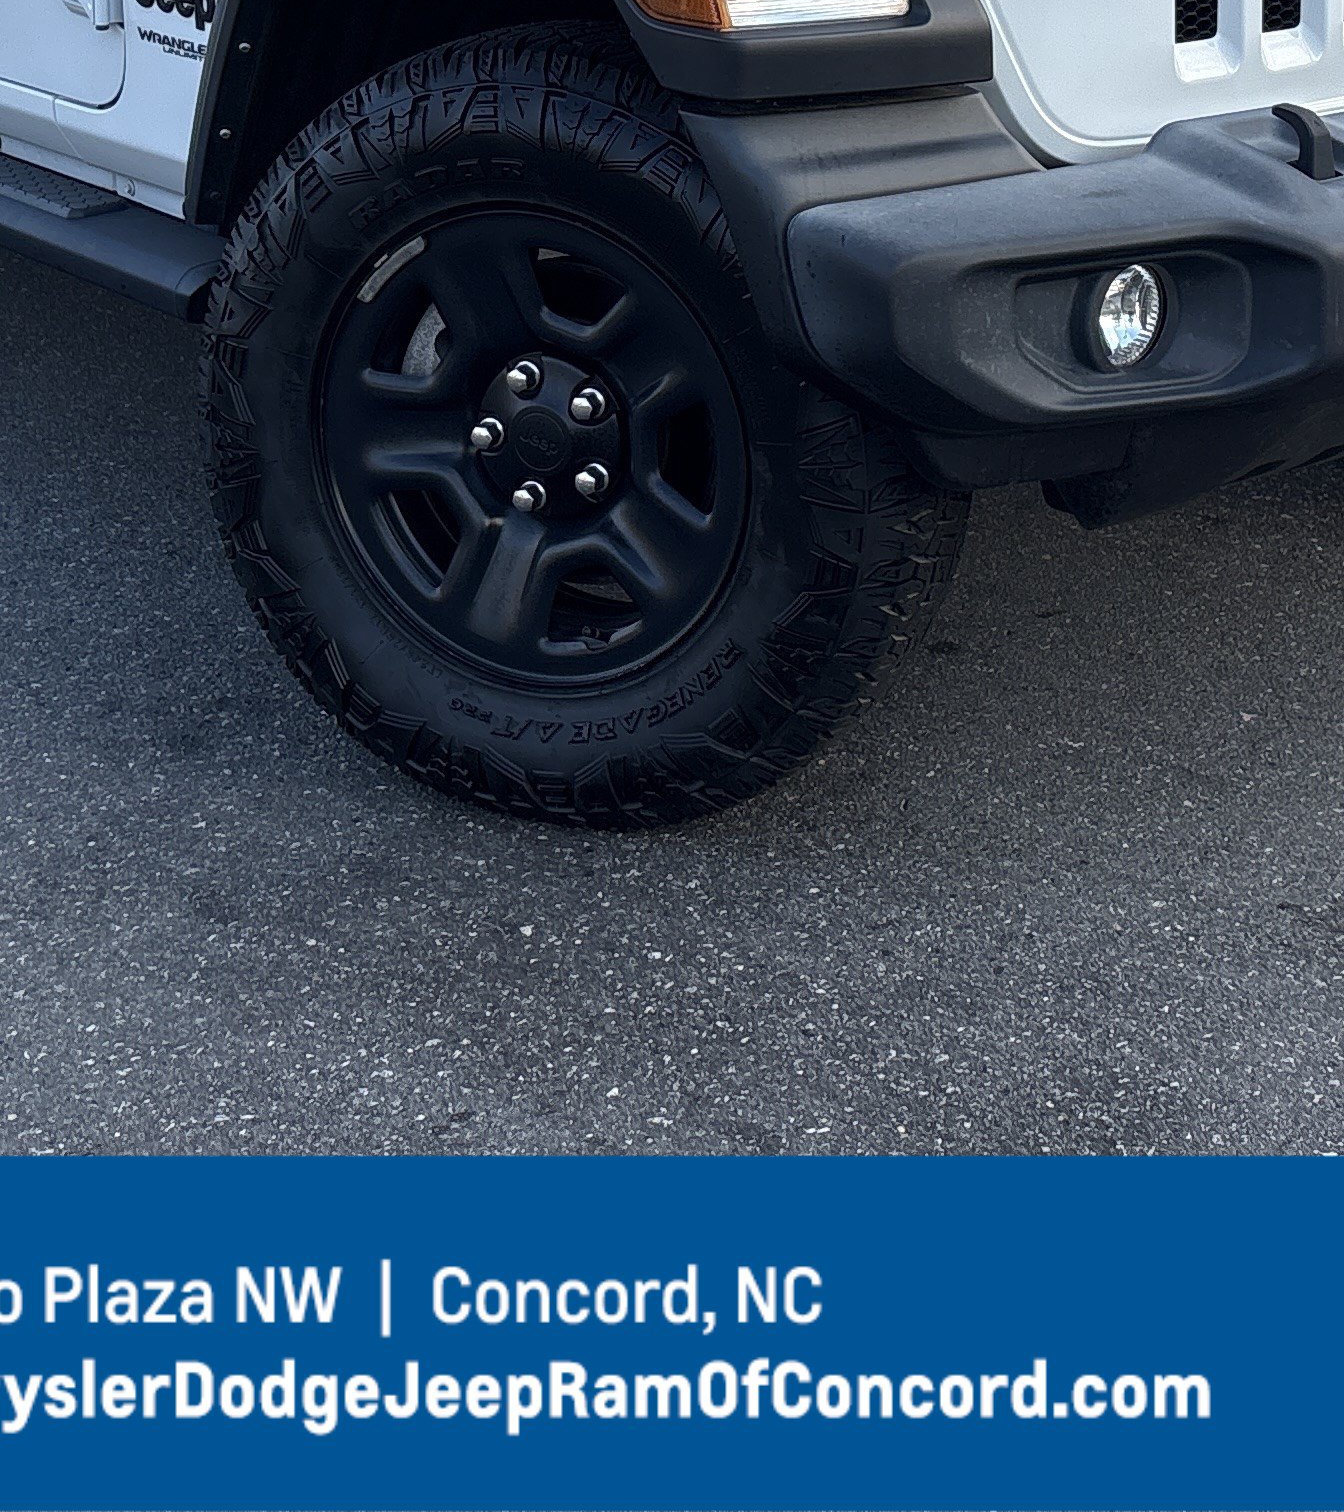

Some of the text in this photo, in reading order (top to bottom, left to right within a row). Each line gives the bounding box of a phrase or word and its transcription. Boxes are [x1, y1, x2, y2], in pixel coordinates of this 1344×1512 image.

[137, 26, 207, 56] WRANGLE
[162, 45, 204, 62] UNLIMIT
[567, 638, 745, 745] RENEGADE
[490, 716, 564, 745] A/T
